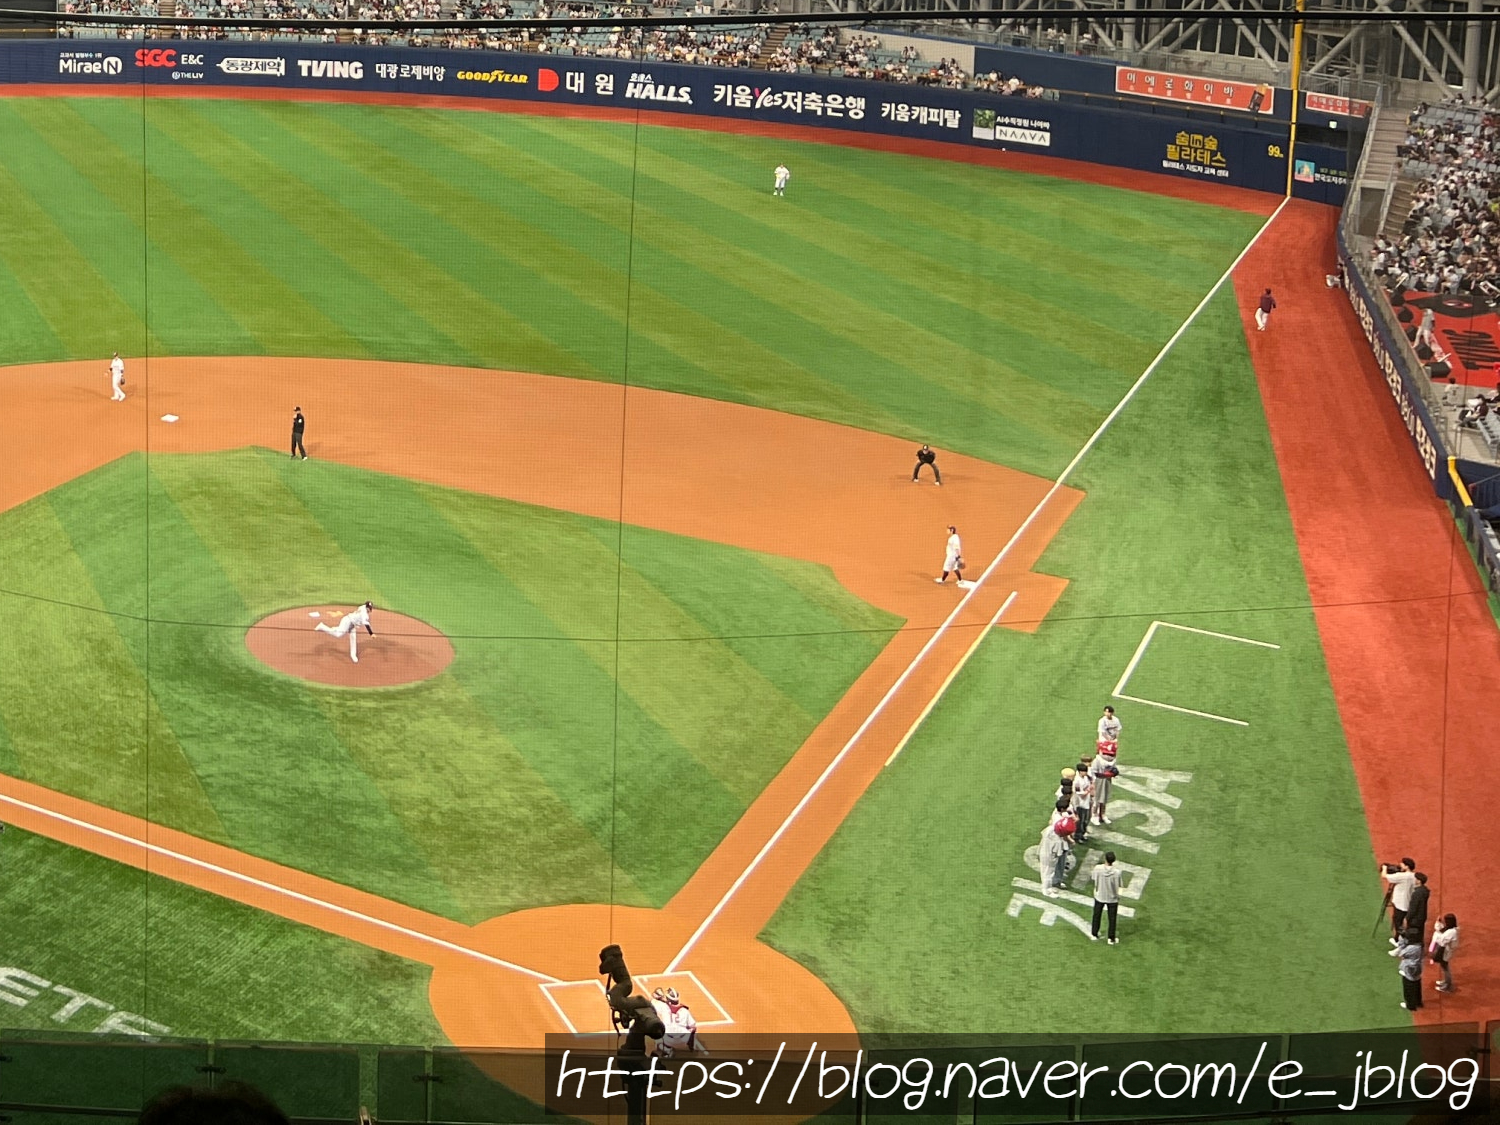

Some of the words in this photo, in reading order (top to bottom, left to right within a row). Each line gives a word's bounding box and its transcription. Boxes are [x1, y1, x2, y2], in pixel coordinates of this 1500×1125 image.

[135, 49, 177, 67] SGC
[181, 54, 204, 65] E&C
[226, 58, 282, 73] 동광제약
[298, 60, 363, 80] TVING
[456, 70, 529, 84] GOODYEAR
[881, 102, 961, 129] 키움캐피탈
[1167, 144, 1227, 167] 필라테스
